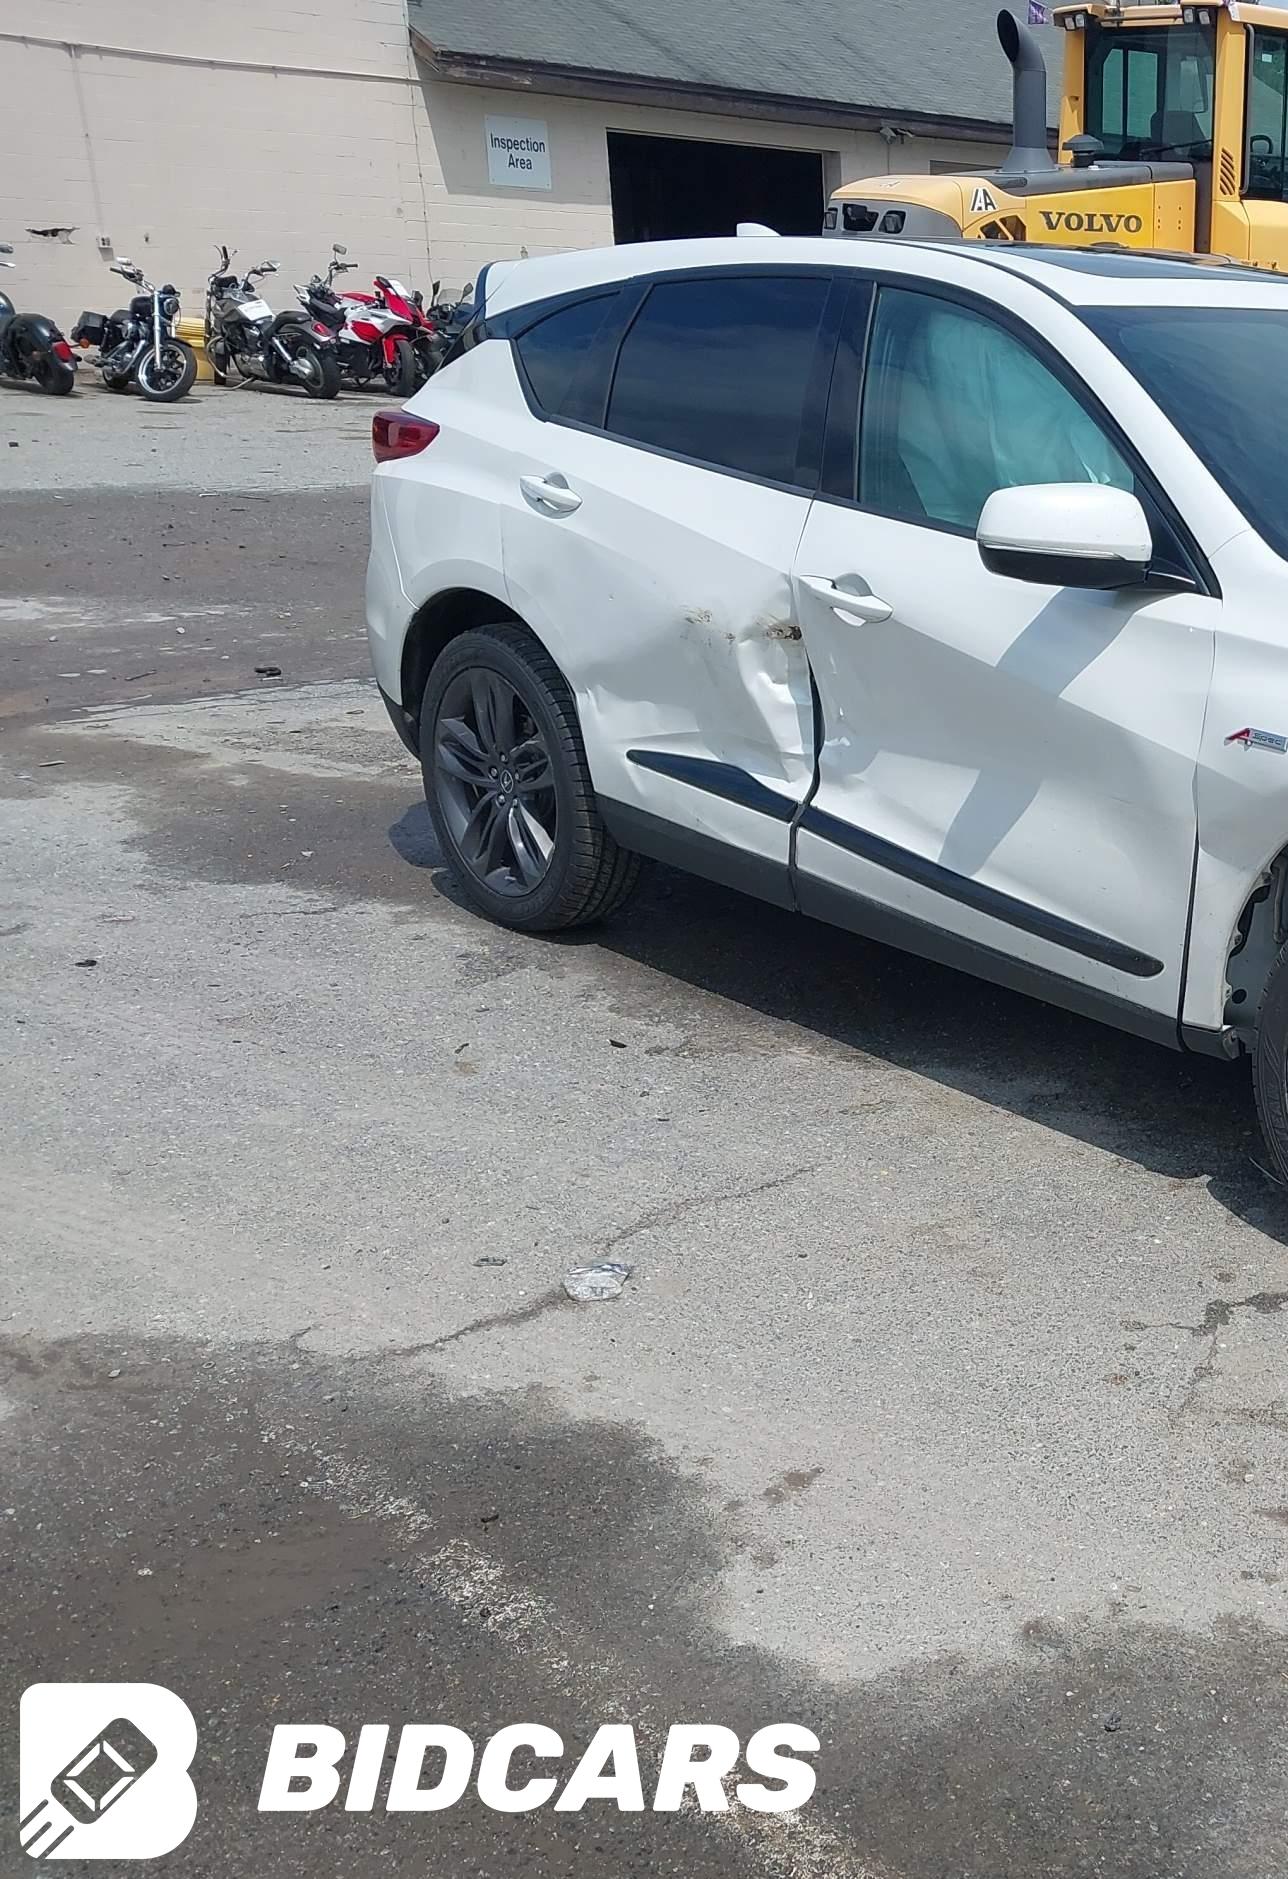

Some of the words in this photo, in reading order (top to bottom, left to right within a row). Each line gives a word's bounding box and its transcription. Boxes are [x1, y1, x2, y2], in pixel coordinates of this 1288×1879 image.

[490, 132, 546, 153] Inspection
[508, 153, 533, 170] Area
[1039, 210, 1143, 234] VOLVO
